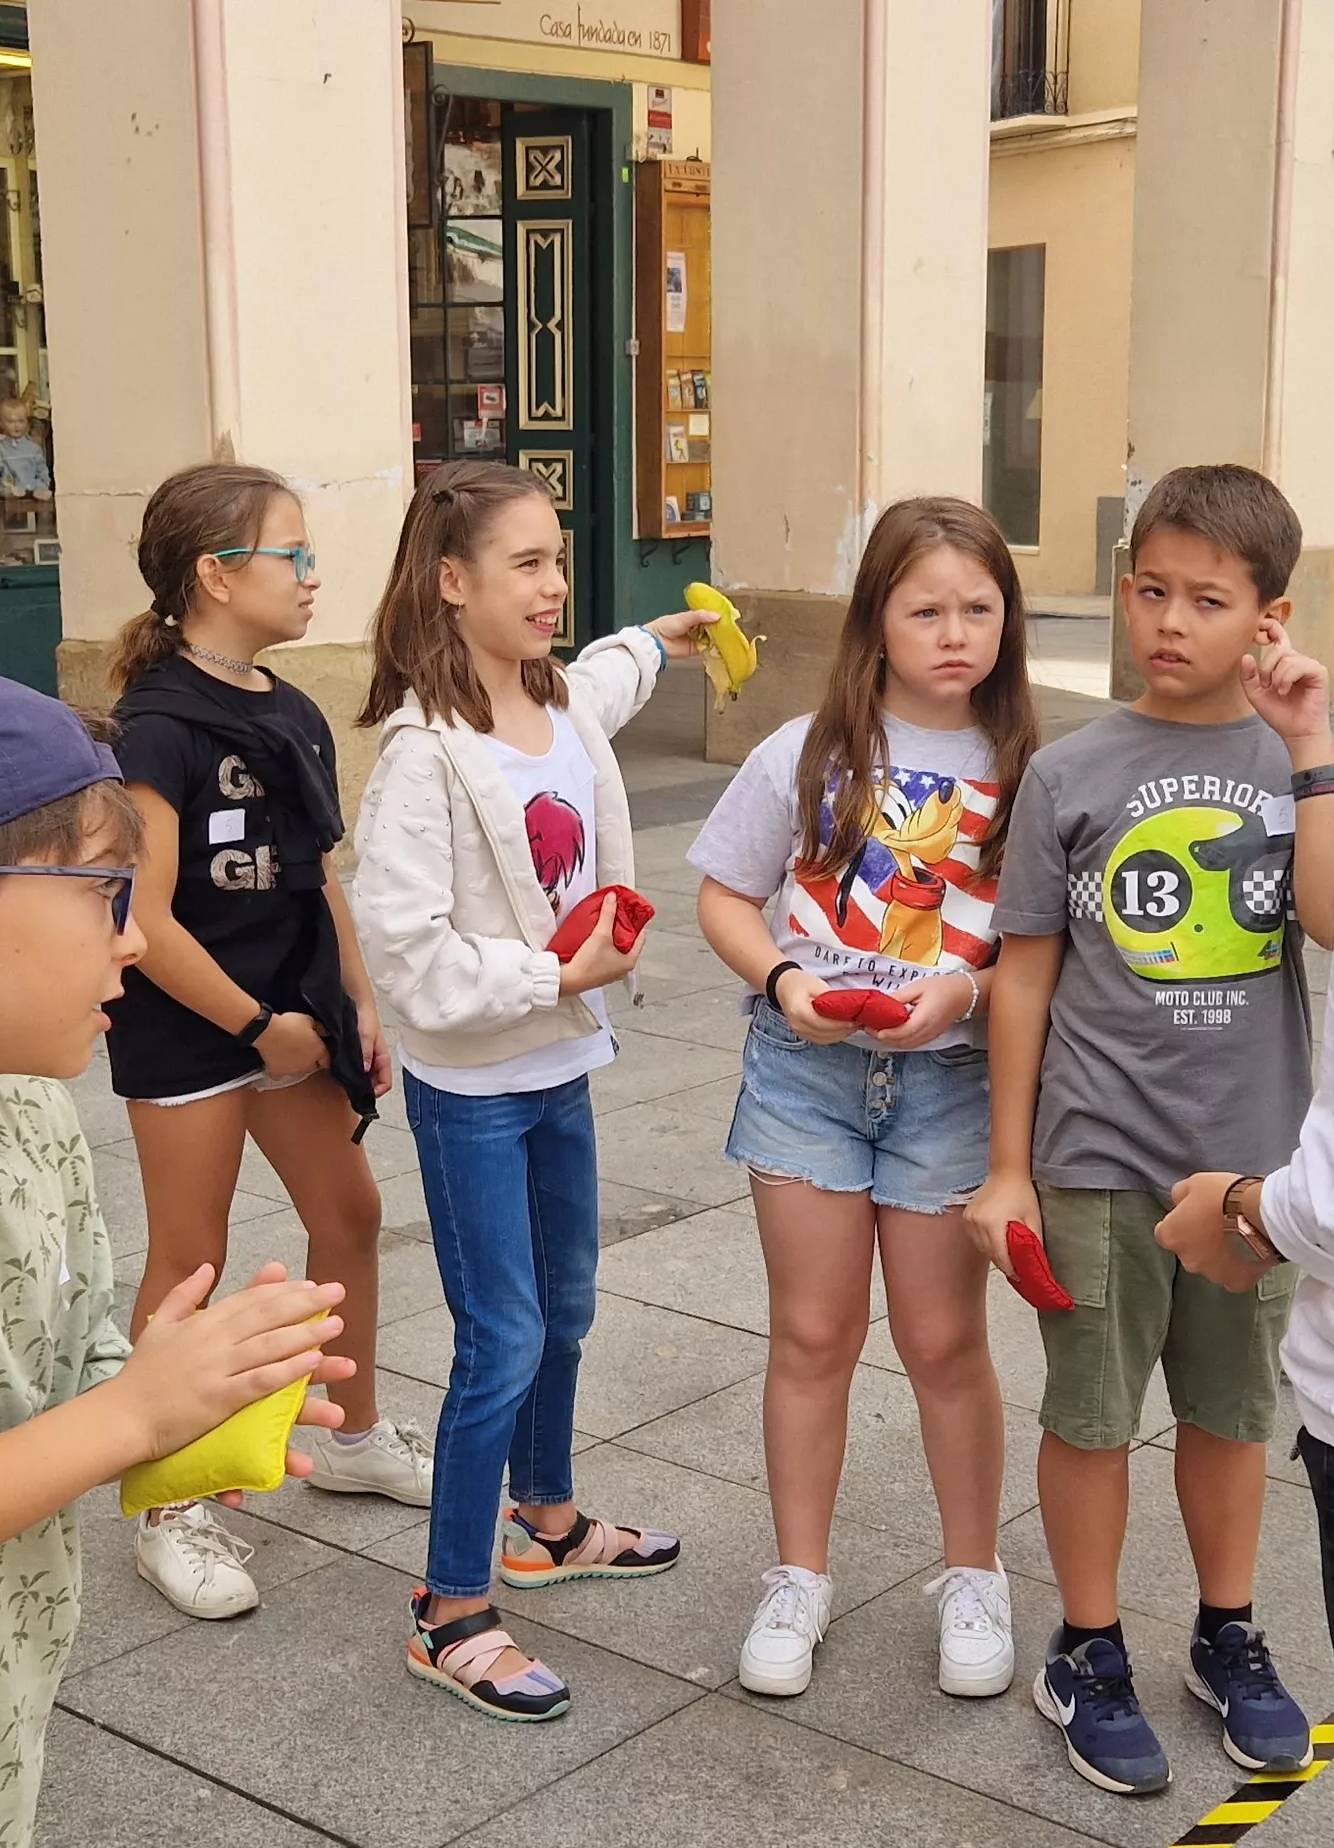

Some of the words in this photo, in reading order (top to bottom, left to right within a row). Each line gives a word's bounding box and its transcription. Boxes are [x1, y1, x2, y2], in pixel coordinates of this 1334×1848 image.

[539, 14, 572, 40] Casa
[577, 4, 626, 46] fundada
[627, 32, 642, 48] en
[648, 31, 672, 55] 1871
[1125, 774, 1275, 818] SUPERIOR
[1121, 870, 1180, 917] 13
[1155, 991, 1189, 1007] MOTO
[1192, 990, 1223, 1006] CLUB
[1226, 990, 1250, 1006] INC.
[1173, 1009, 1198, 1025] EST.
[1202, 1008, 1232, 1024] 1998
